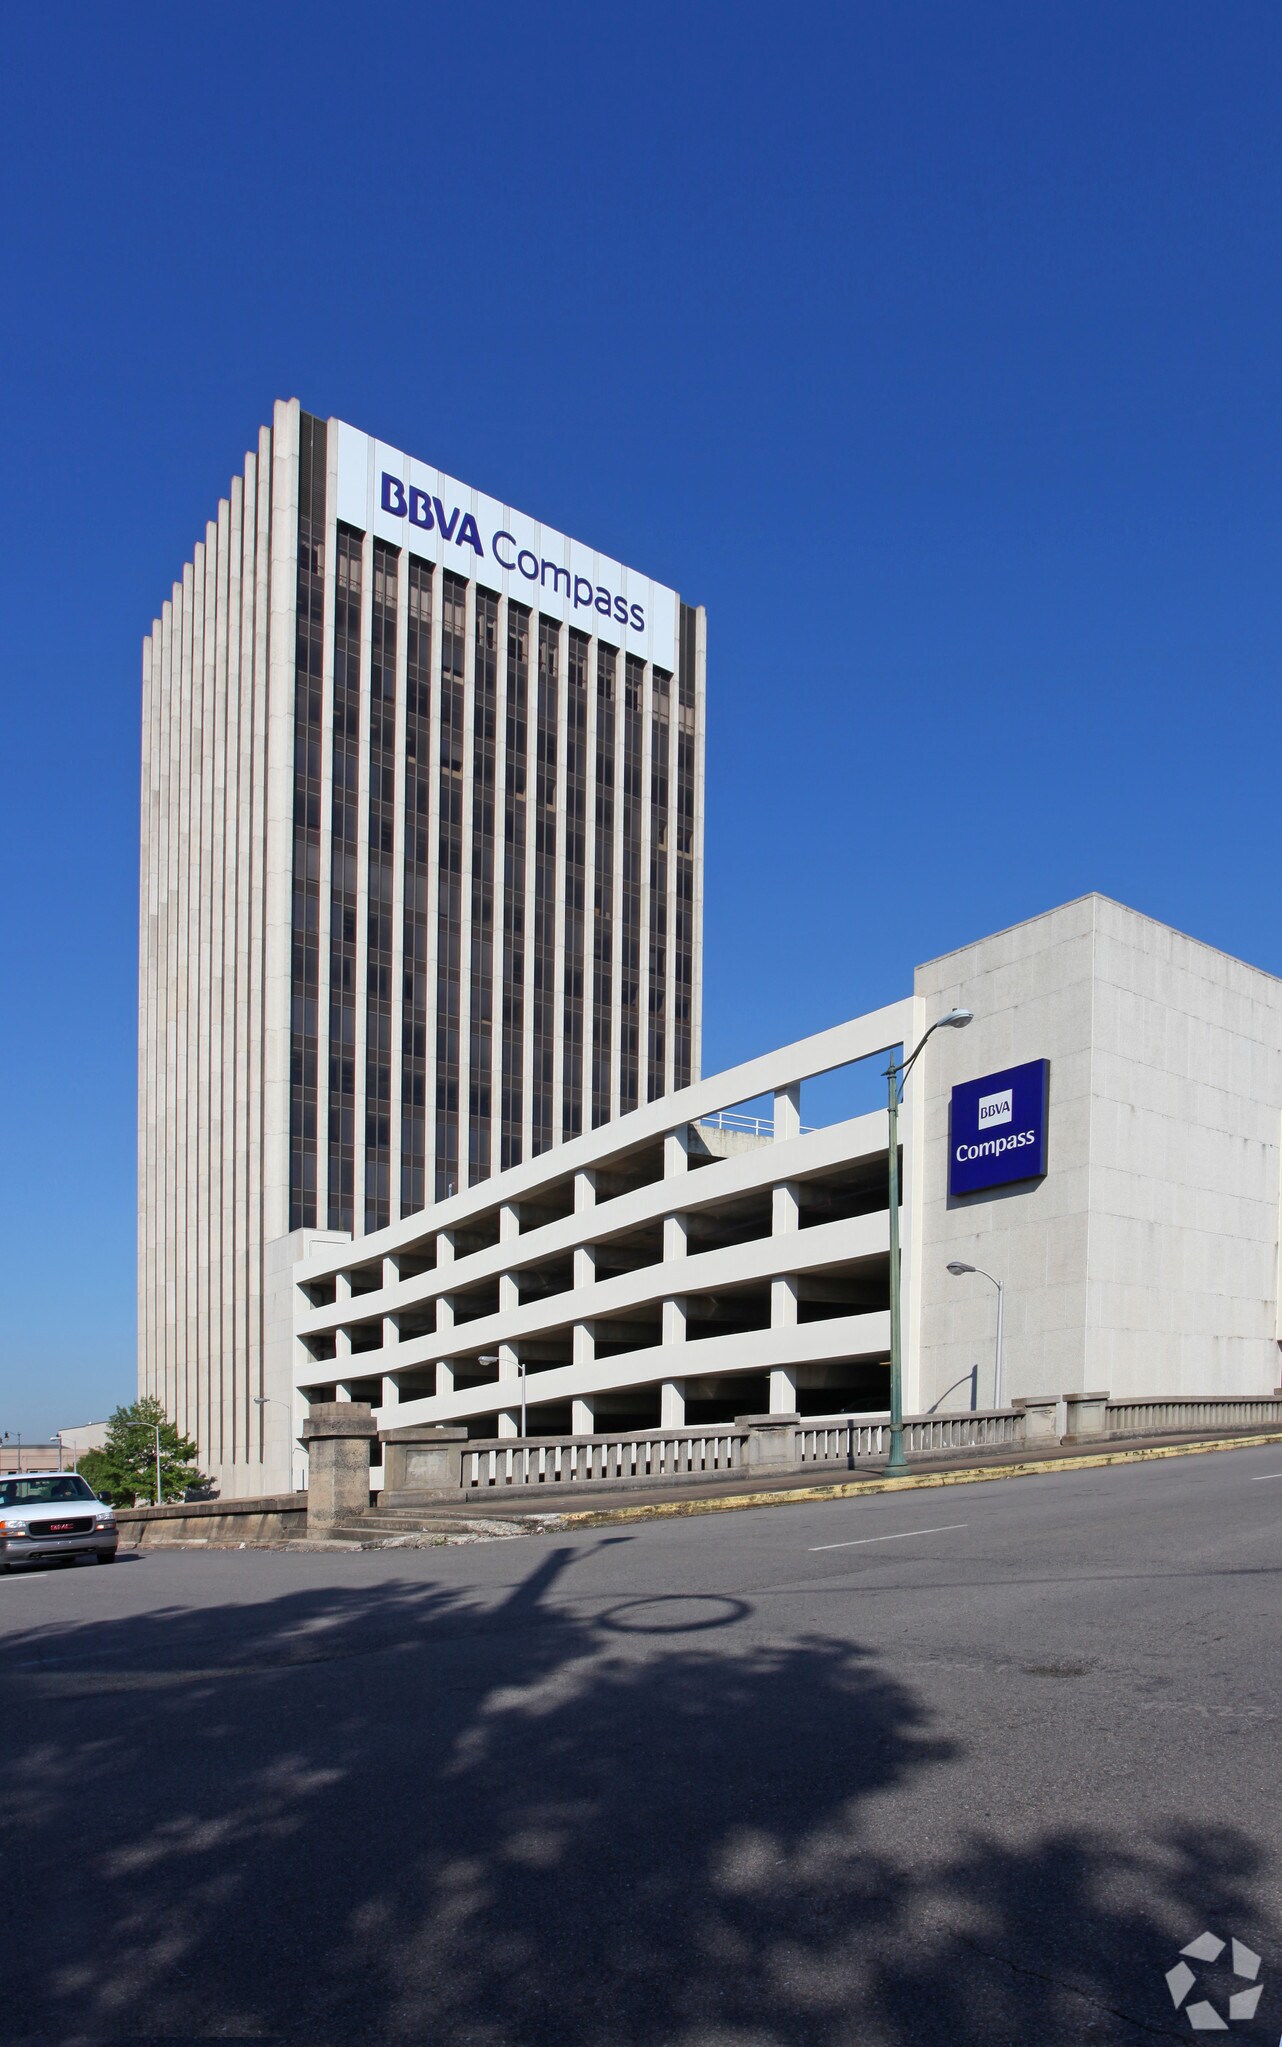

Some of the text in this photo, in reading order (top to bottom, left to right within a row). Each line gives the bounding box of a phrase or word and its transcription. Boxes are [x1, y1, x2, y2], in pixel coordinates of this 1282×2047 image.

[381, 471, 645, 632] BBVA Compass
[980, 1100, 1010, 1119] BBVA
[956, 1130, 1035, 1162] Compass
